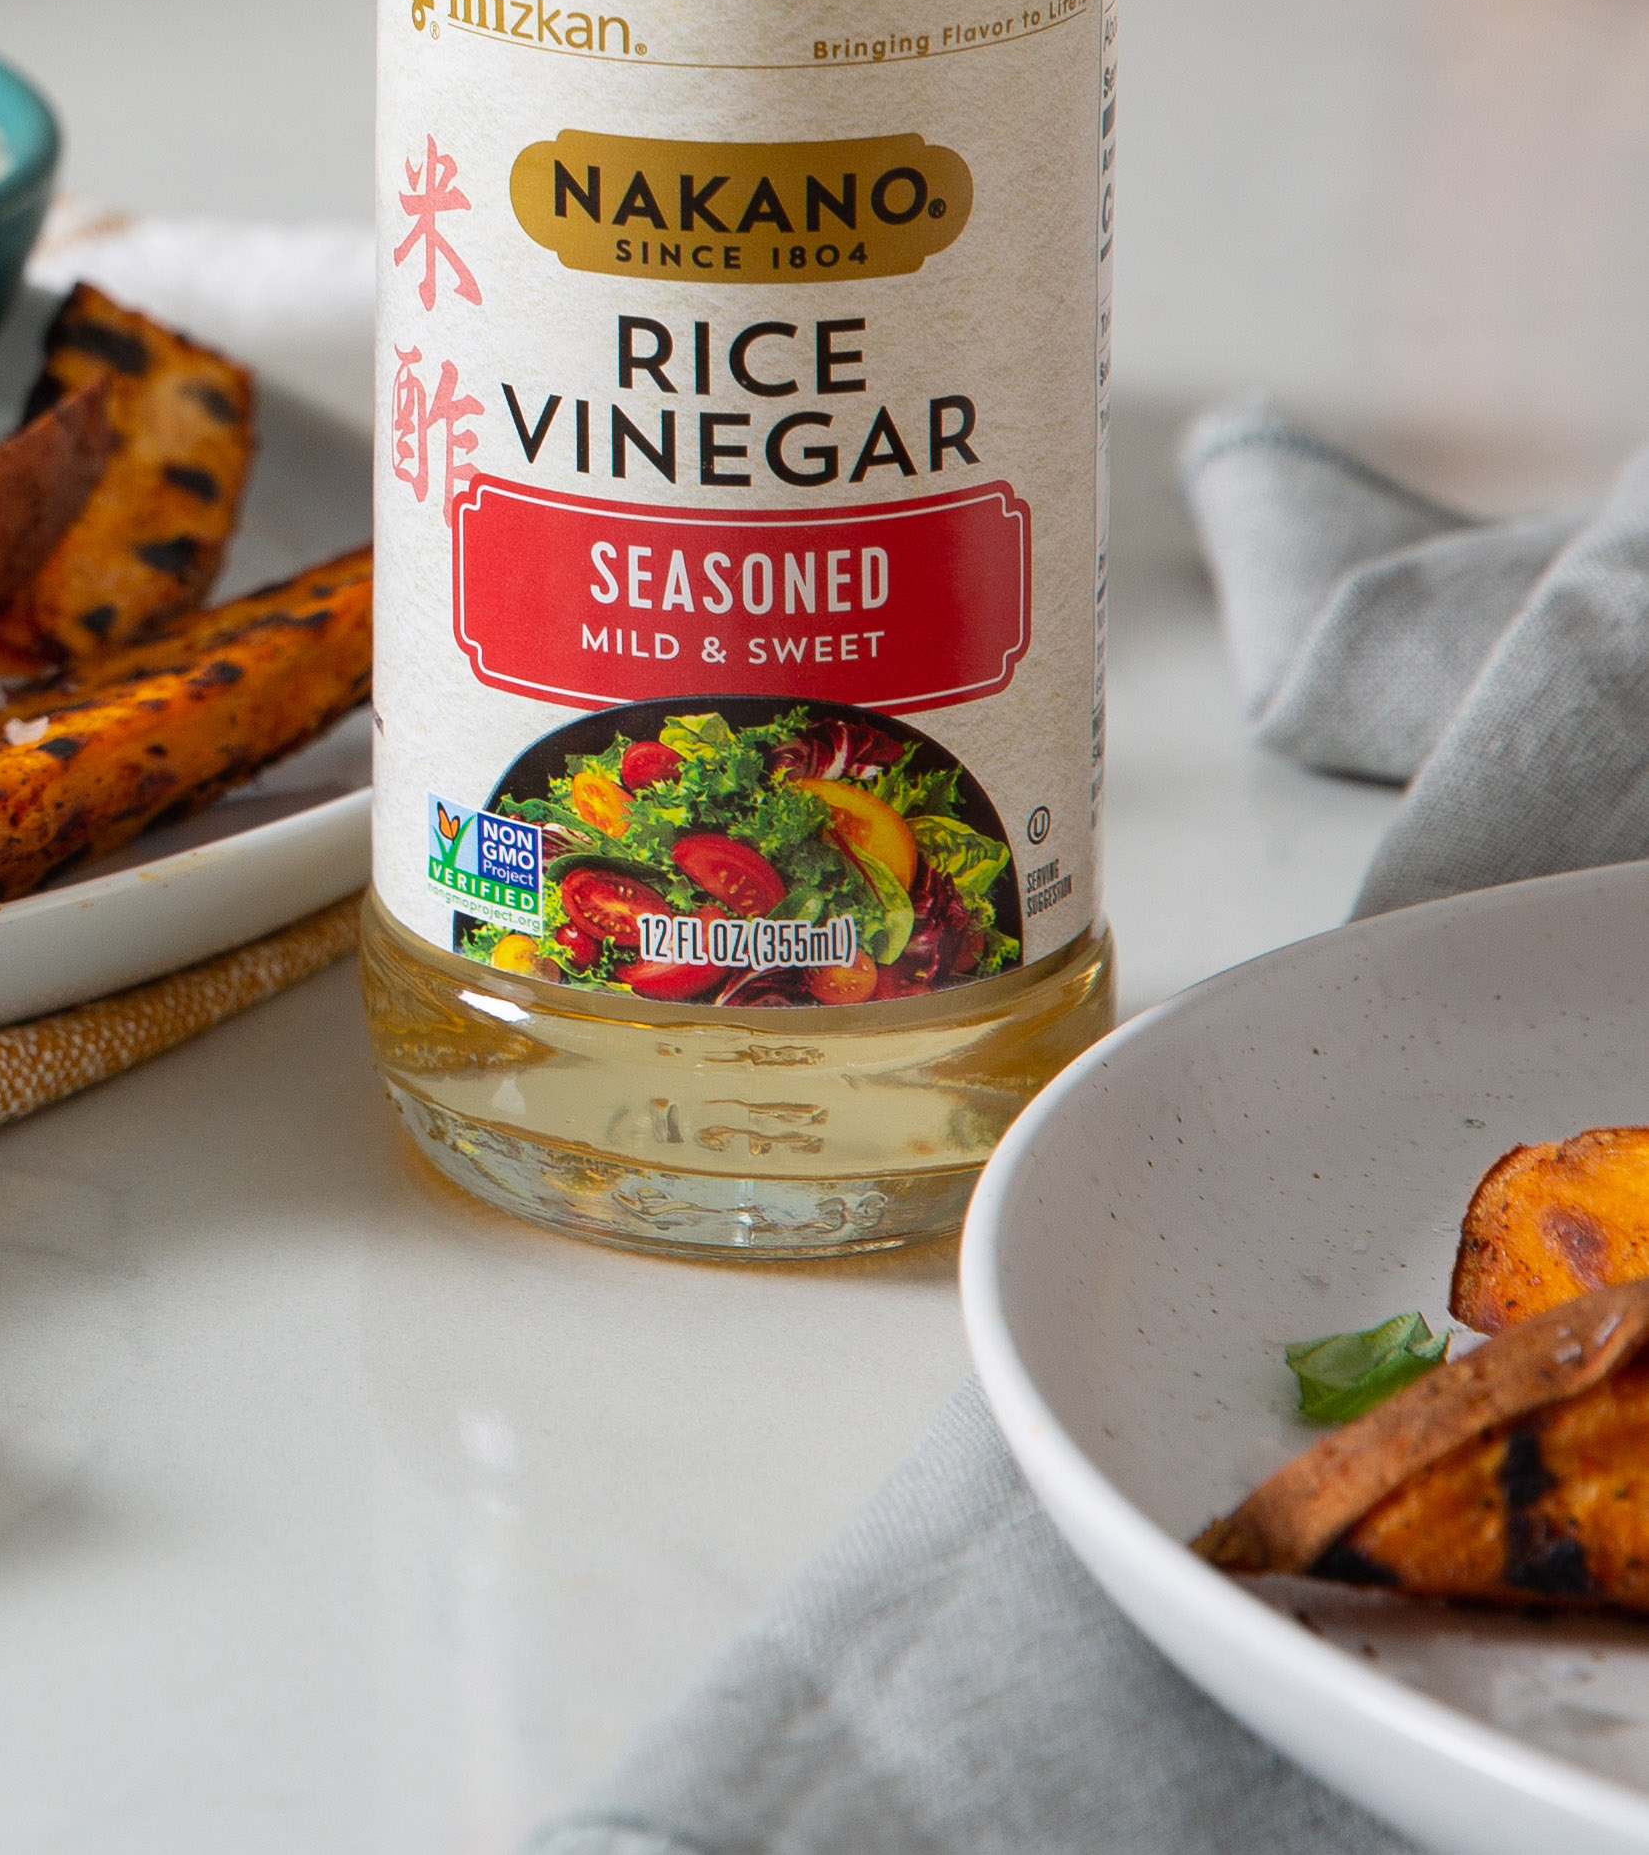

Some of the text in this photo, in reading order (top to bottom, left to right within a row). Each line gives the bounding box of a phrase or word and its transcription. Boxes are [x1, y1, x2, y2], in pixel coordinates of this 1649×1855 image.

[814, 34, 930, 61] Bringing
[943, 18, 1014, 46] Flavor
[1022, 9, 1041, 28] to
[615, 238, 868, 269] SINCE 1804
[617, 314, 867, 398] RICE
[501, 382, 982, 487] VINEGAR
[590, 541, 889, 615] SEASONED
[582, 623, 885, 665] MILD & SWEET
[482, 841, 535, 870] GMO
[483, 820, 533, 851] NON
[432, 861, 535, 911] VERIFIED
[483, 859, 534, 887] Project
[427, 883, 541, 932] nongmoproject.org
[642, 918, 852, 966] 12 FL OZ (355mL)
